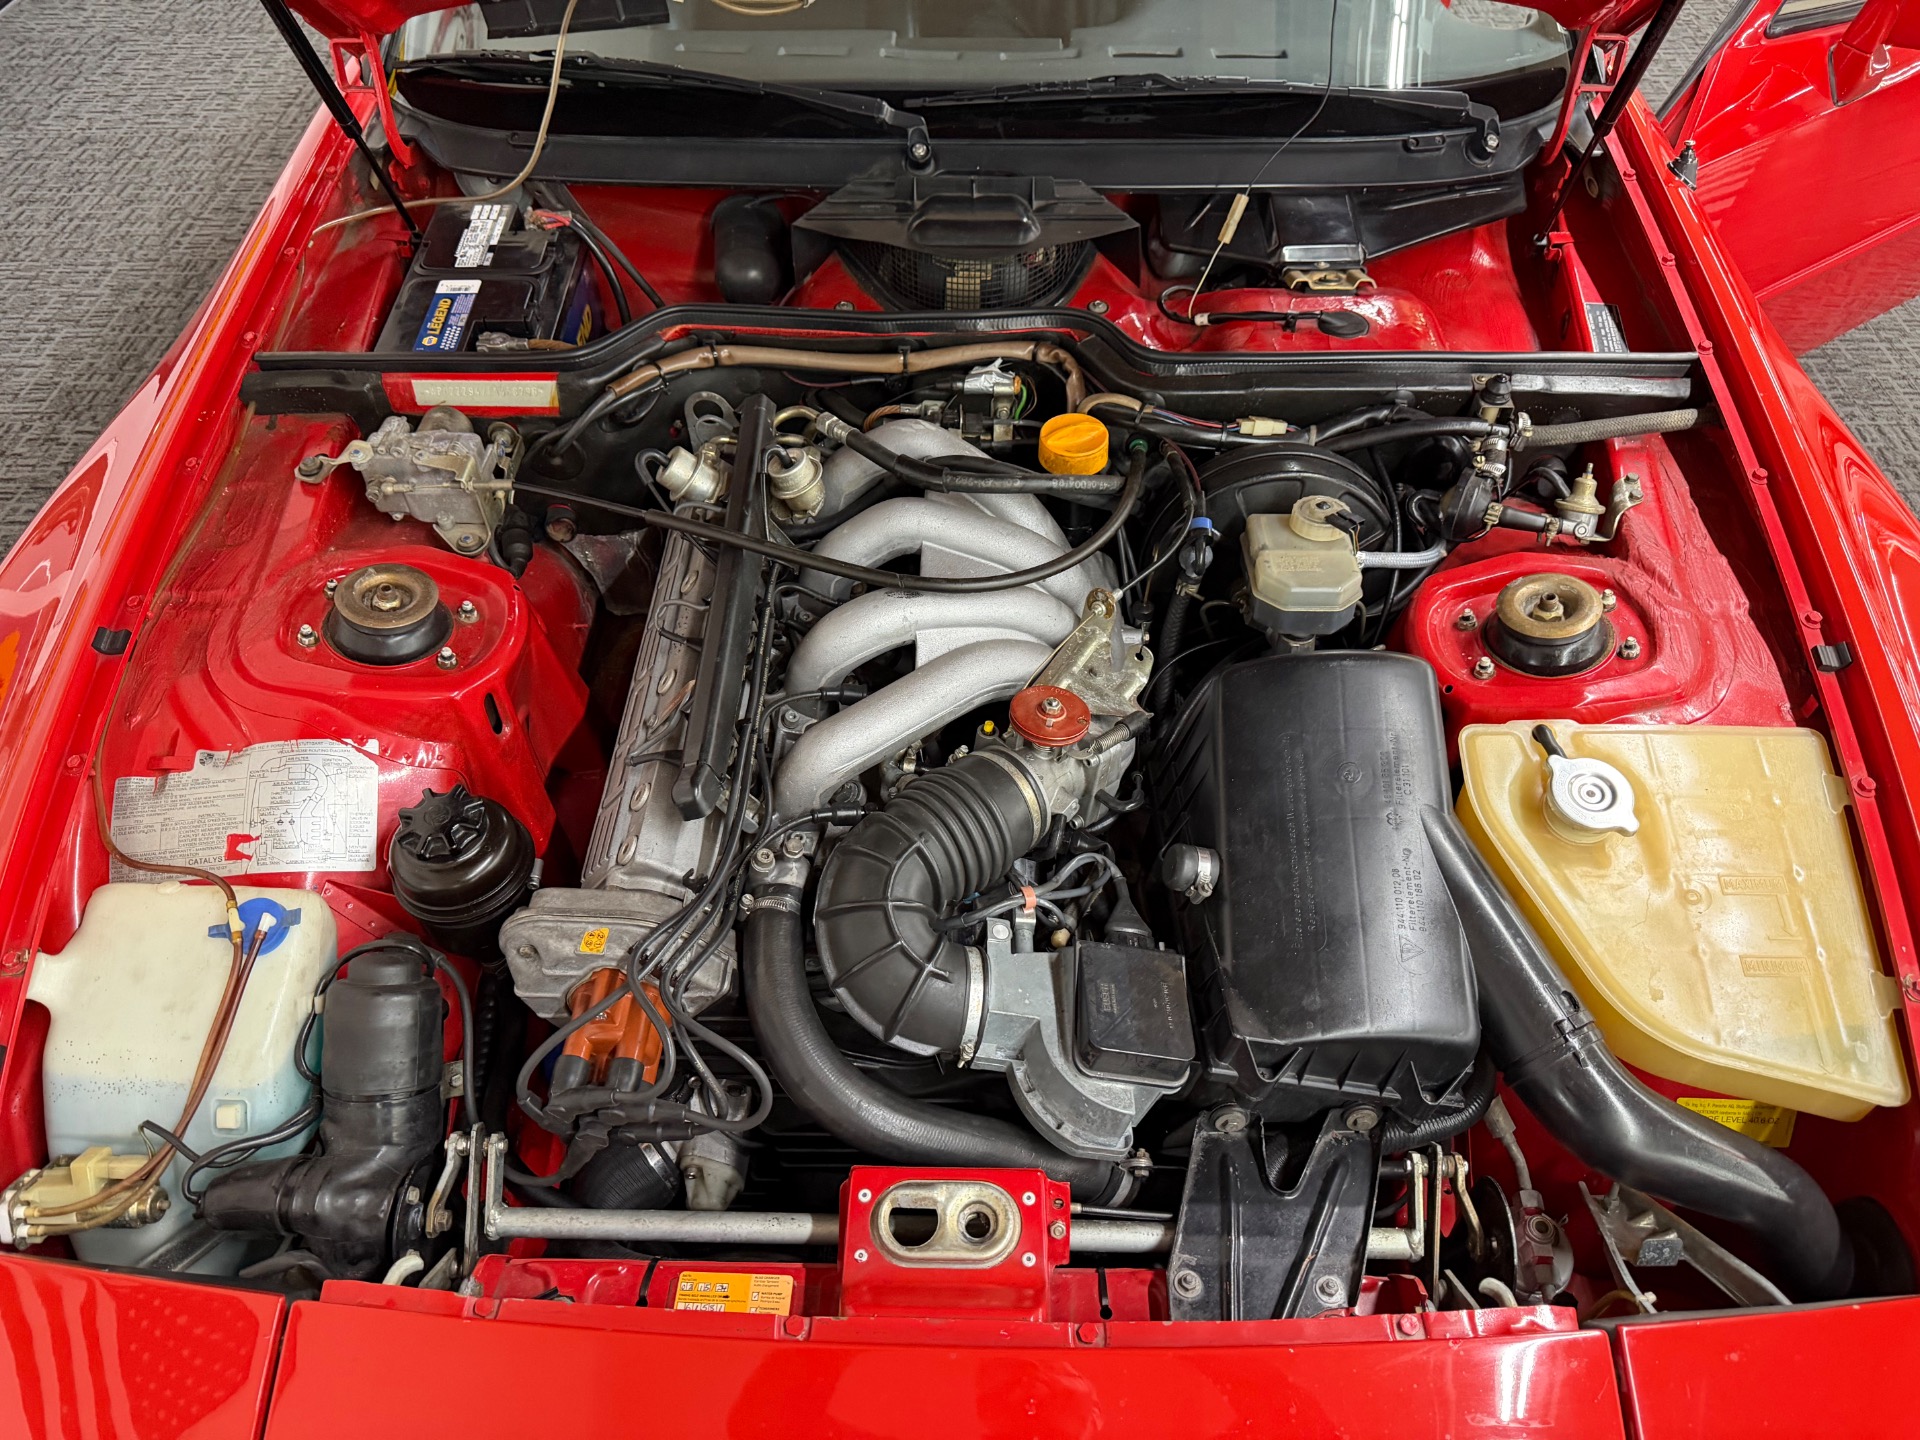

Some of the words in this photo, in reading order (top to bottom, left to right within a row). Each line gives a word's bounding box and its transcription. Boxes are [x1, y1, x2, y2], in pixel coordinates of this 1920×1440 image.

[427, 298, 452, 334] LEGEND
[1723, 878, 1785, 890] MAXIMUM
[1744, 960, 1807, 972] MINIMUM
